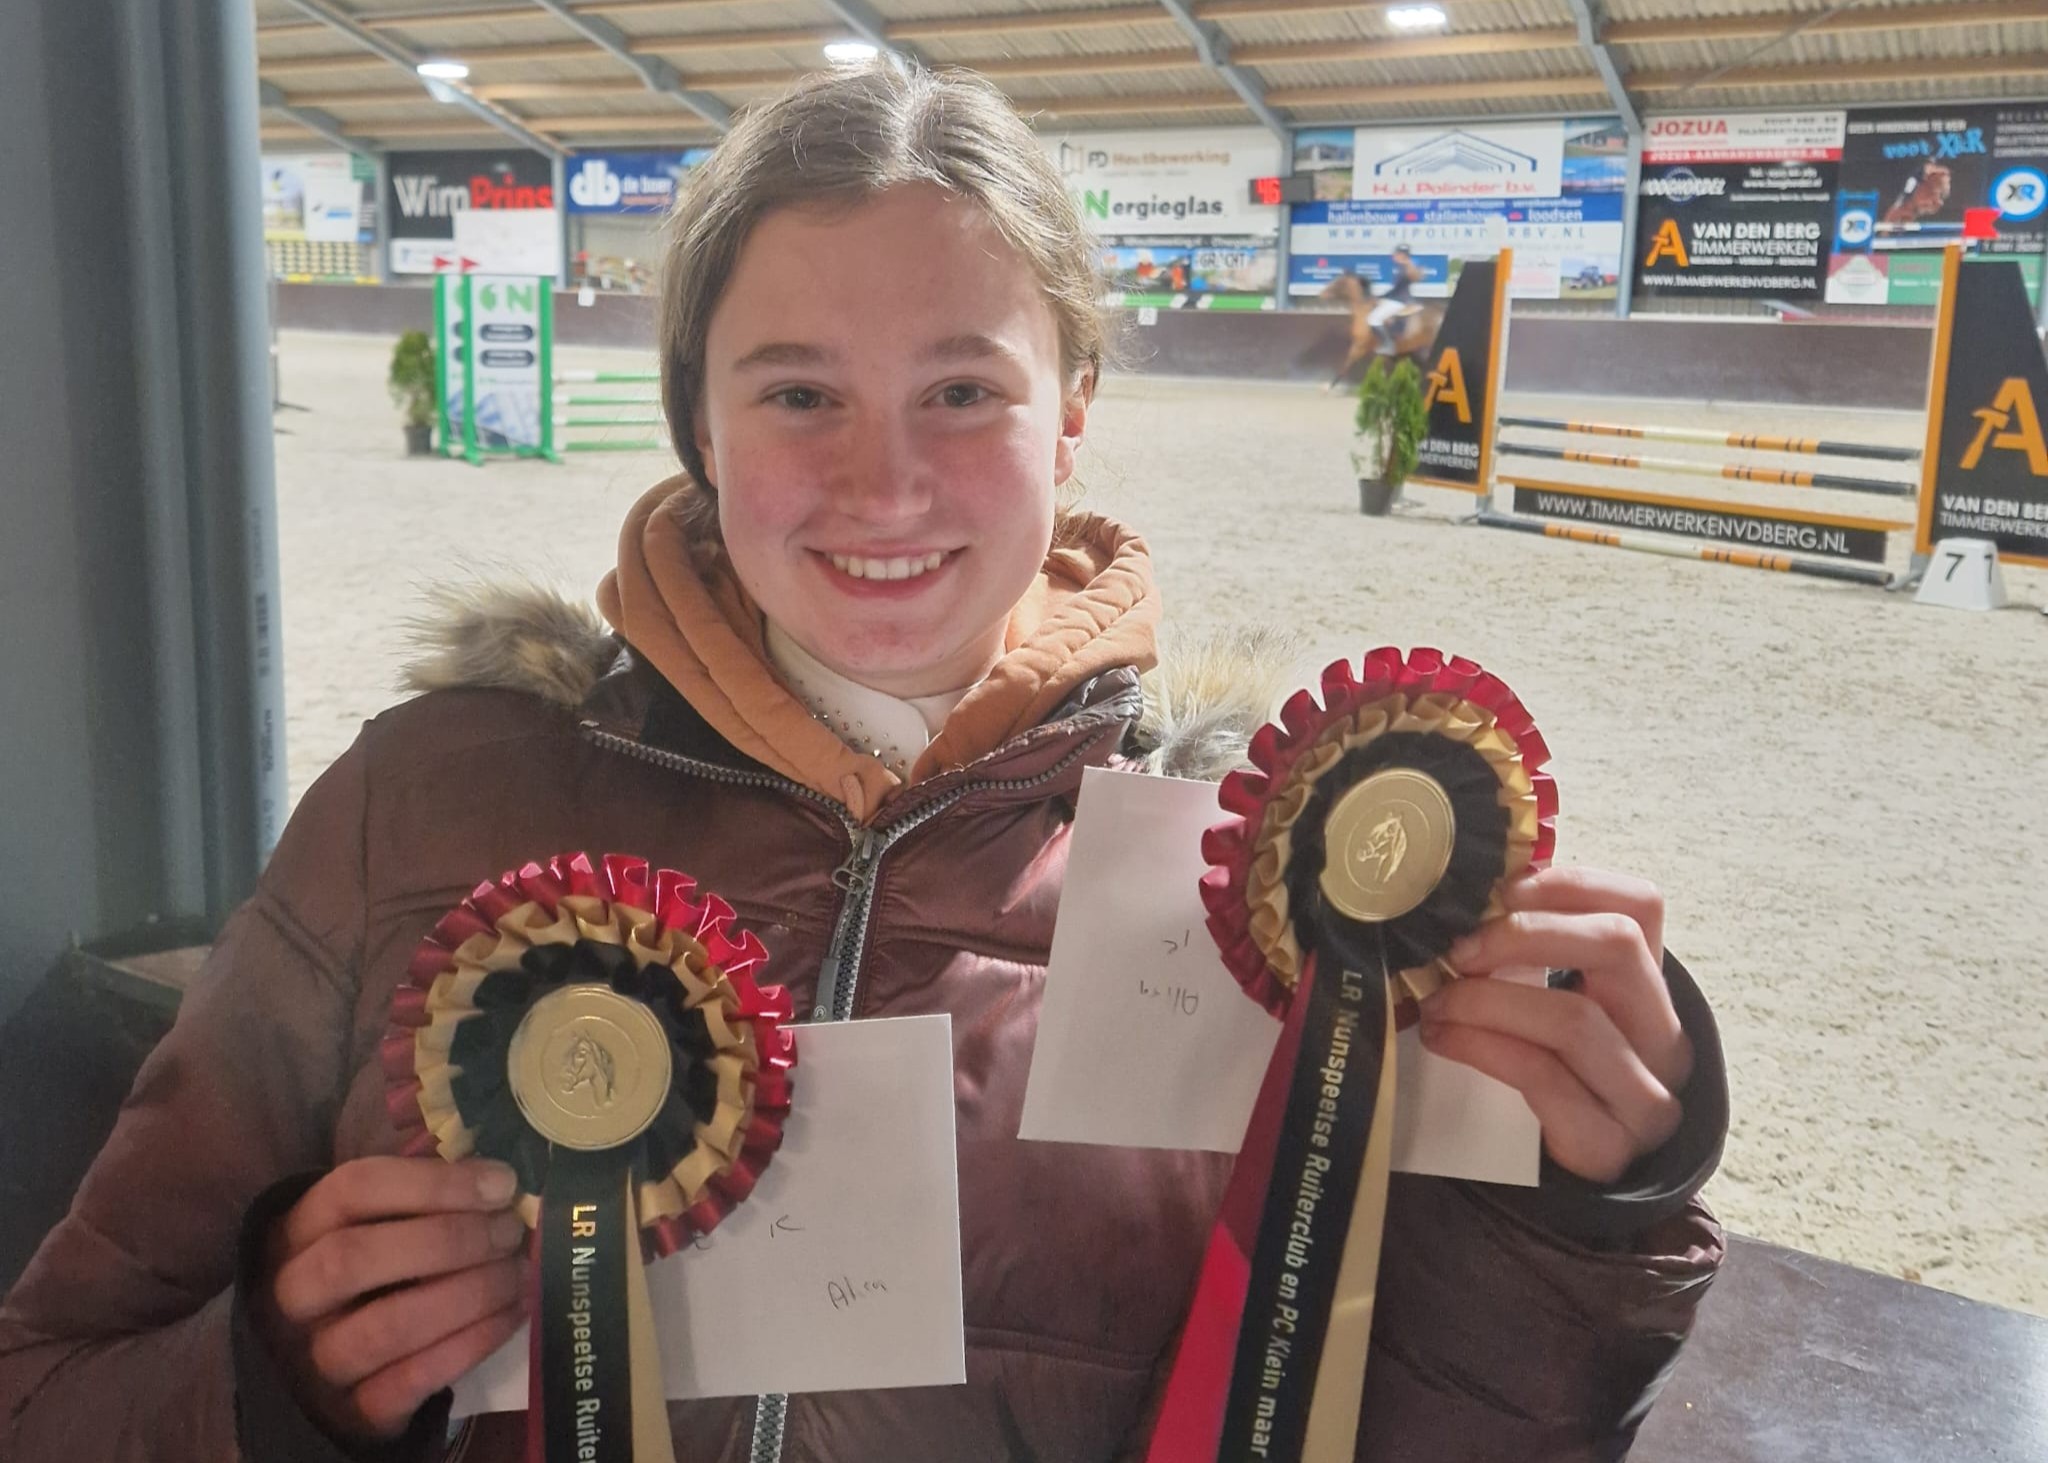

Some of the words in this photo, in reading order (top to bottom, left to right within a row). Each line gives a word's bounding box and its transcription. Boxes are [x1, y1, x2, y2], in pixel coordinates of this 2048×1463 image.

[1650, 119, 1728, 137] JOZUA
[1085, 189, 1223, 220] Nergieglas
[1692, 222, 1732, 239] VAN
[1734, 222, 1771, 240] DEN
[1773, 222, 1821, 240] BERG
[1691, 239, 1819, 256] TIMMERWERKEN
[1452, 441, 1480, 458] BERG
[1536, 491, 1850, 554] WWW.TIMMERWERKENVDBERG.NL
[1941, 495, 1980, 514] VAN
[1983, 498, 2019, 518] DEN
[1945, 552, 1966, 583] 7
[1310, 1008, 1360, 1148] Nunspeetse
[571, 1204, 598, 1238] LR
[1285, 1152, 1331, 1268] Ruiterclub
[1279, 1273, 1299, 1300] en
[567, 1246, 598, 1392] Nunspeetse
[1272, 1301, 1299, 1335] PC
[1260, 1333, 1292, 1389] Klein
[1251, 1395, 1277, 1458] maar
